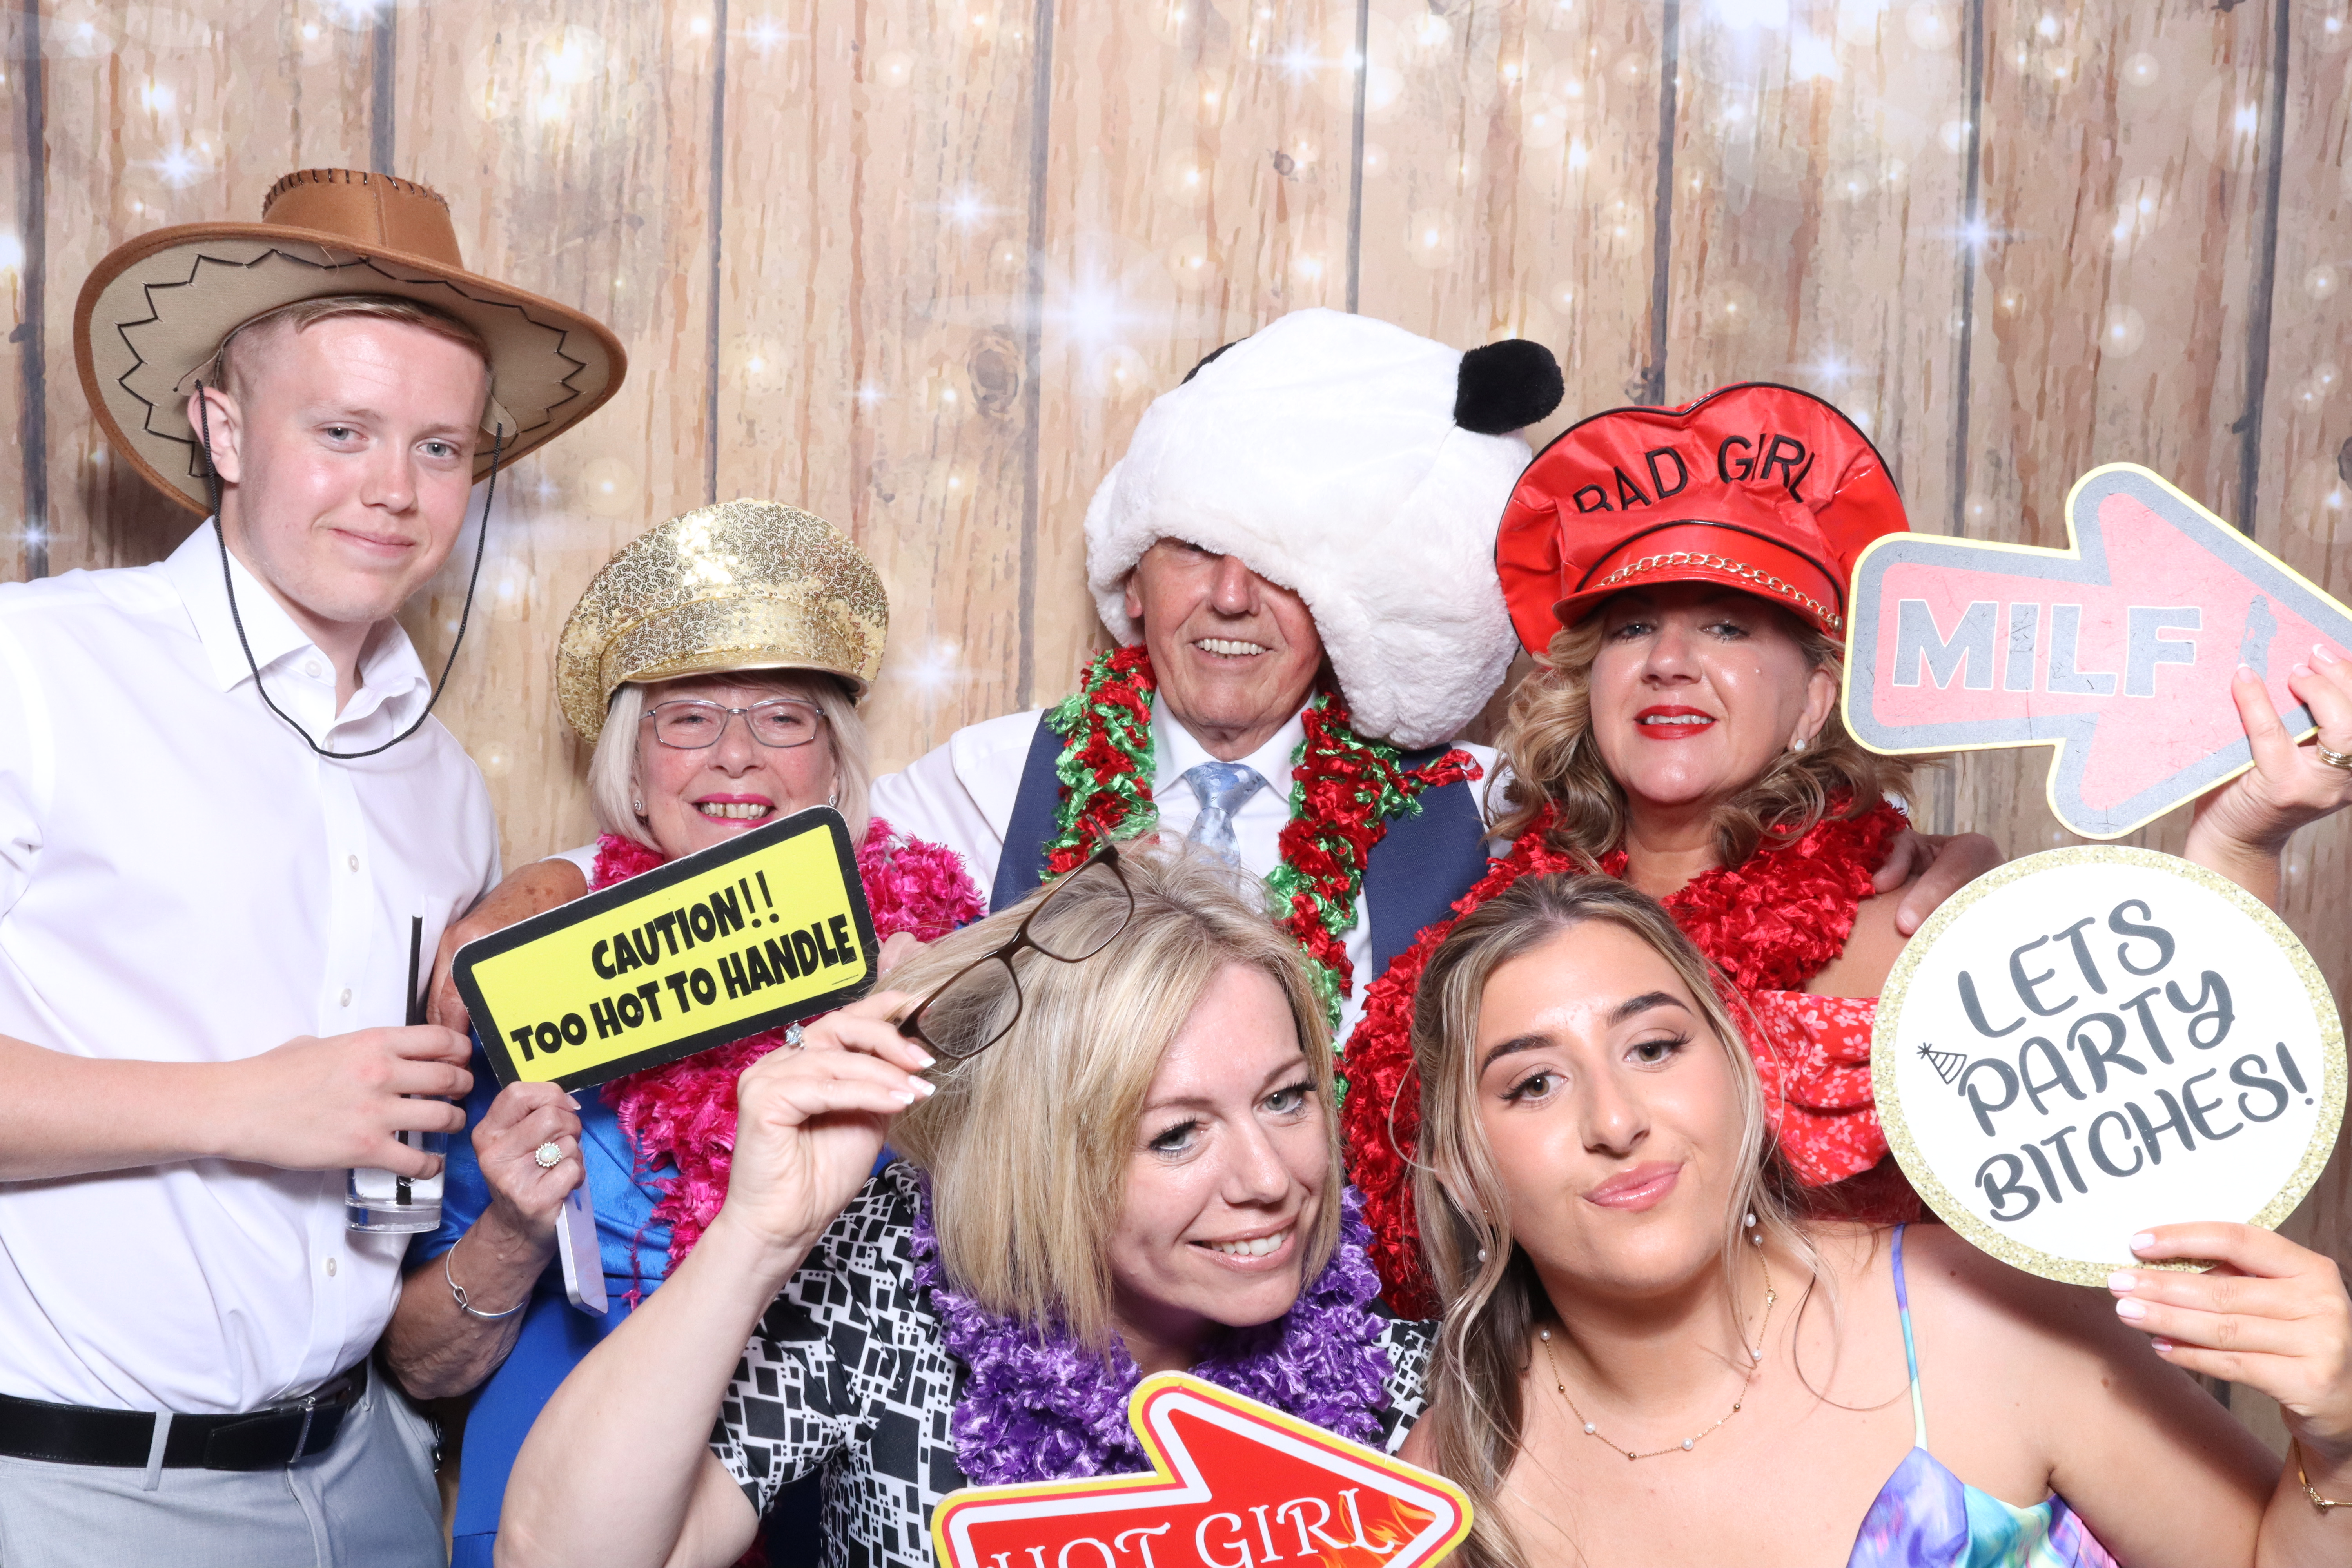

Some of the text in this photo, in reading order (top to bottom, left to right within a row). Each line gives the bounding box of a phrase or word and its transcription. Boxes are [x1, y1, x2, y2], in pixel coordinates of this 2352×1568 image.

[1717, 433, 1815, 503] GIRL
[1892, 599, 2202, 698] MILF
[591, 870, 779, 980] CAUTION!!
[1958, 899, 2175, 1038] LETS
[510, 913, 857, 1062] TOO HOT TO HANDLE
[1958, 970, 2235, 1137] PARTY
[1975, 1042, 2314, 1222] BITCHES!
[1195, 1488, 1395, 1568] GIRL
